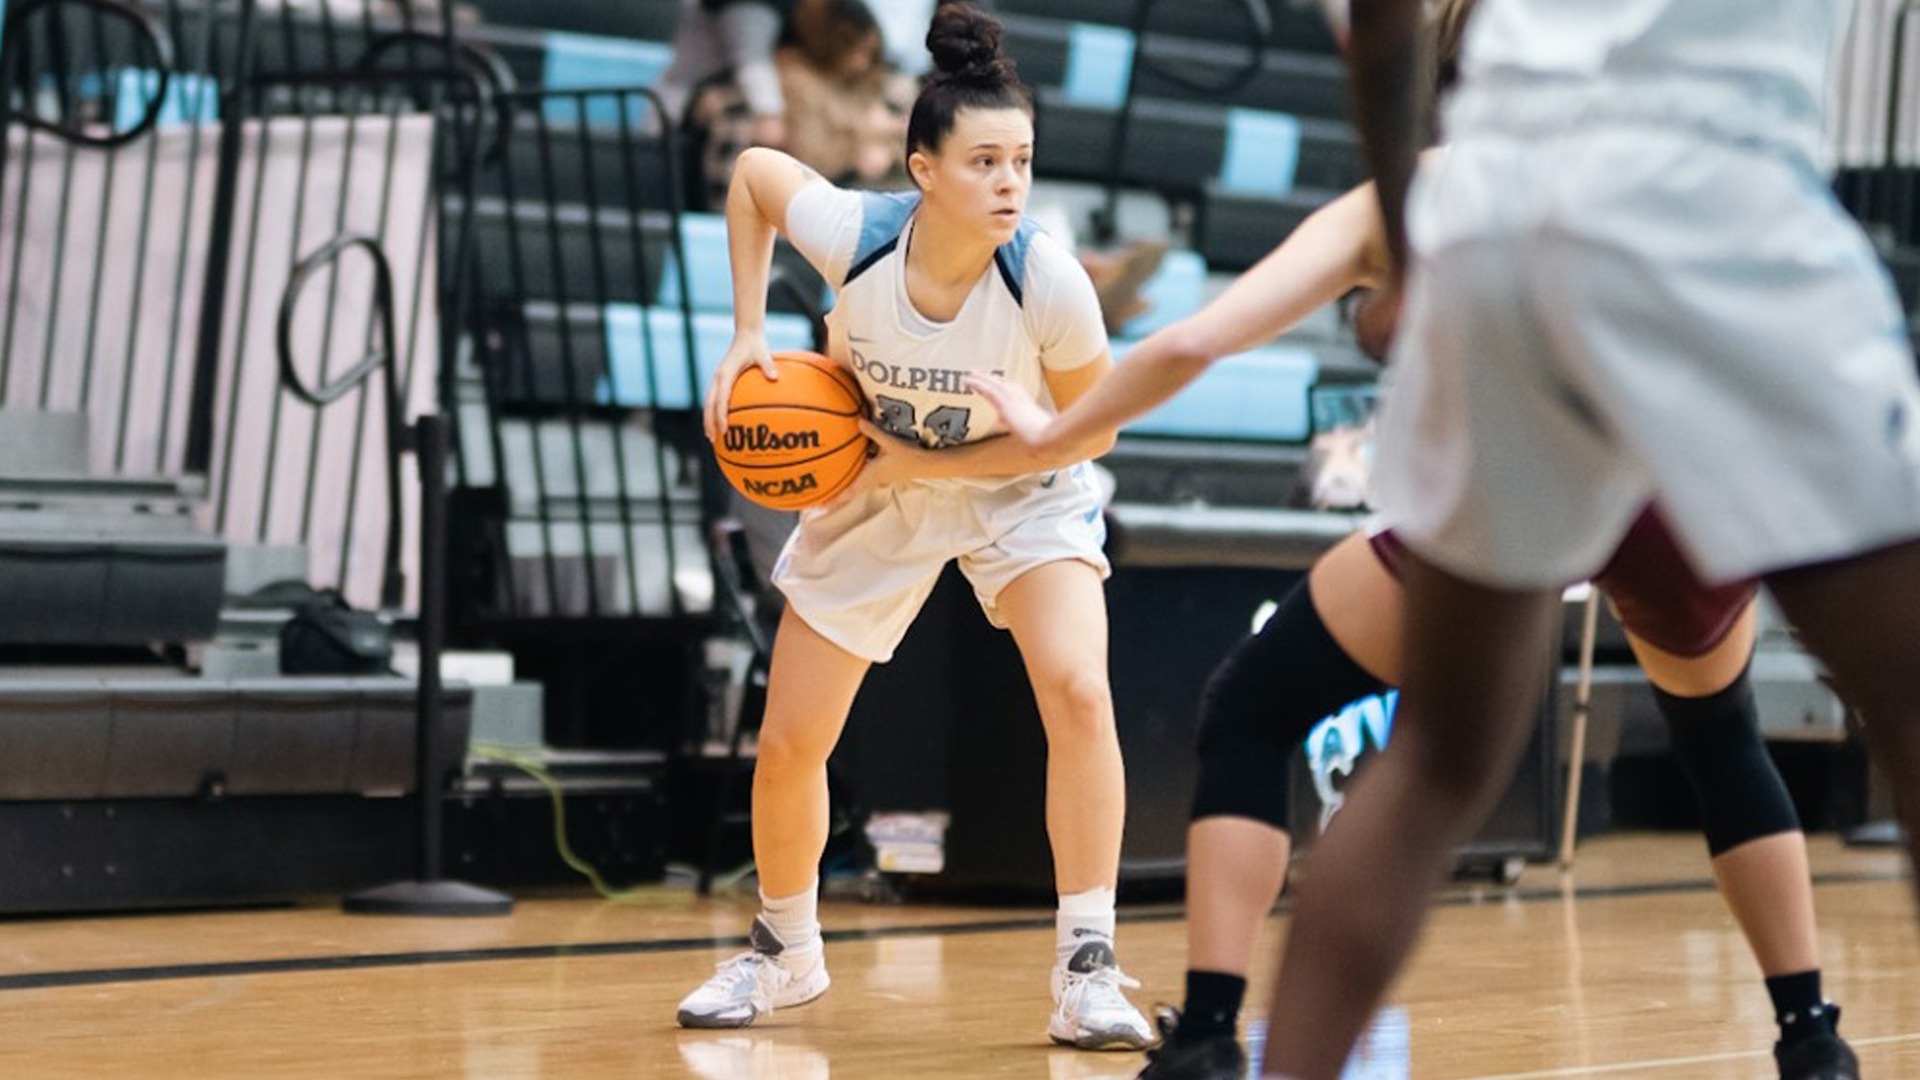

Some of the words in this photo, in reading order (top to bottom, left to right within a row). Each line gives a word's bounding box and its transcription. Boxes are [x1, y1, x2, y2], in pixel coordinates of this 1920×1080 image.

[851, 349, 1005, 395] DOLPHI
[723, 424, 820, 452] Wilson
[742, 472, 818, 497] NCAA
